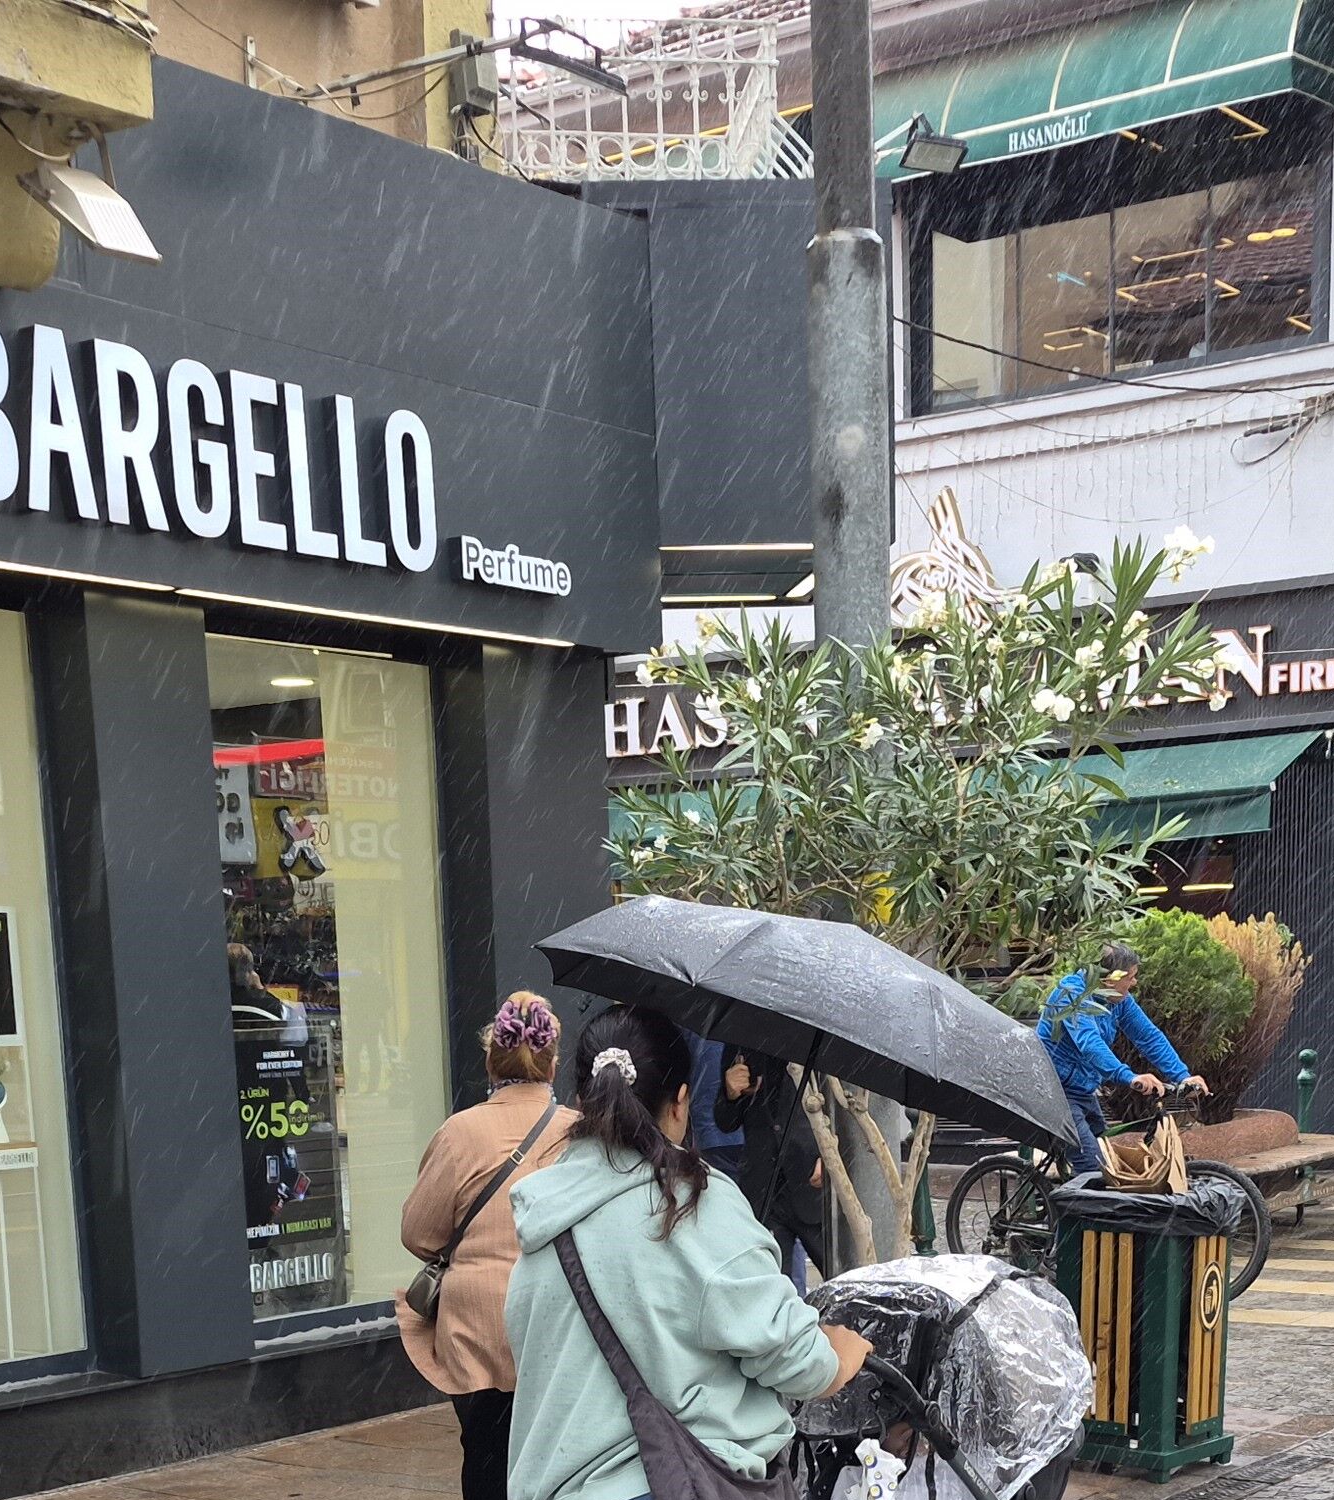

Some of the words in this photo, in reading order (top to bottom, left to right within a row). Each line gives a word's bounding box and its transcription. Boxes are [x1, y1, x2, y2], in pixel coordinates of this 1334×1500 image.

[463, 537, 571, 596] Perfume
[248, 1087, 269, 1099] ÜRÜN
[241, 1100, 309, 1140] %50
[250, 1252, 334, 1293] BARGELLO
